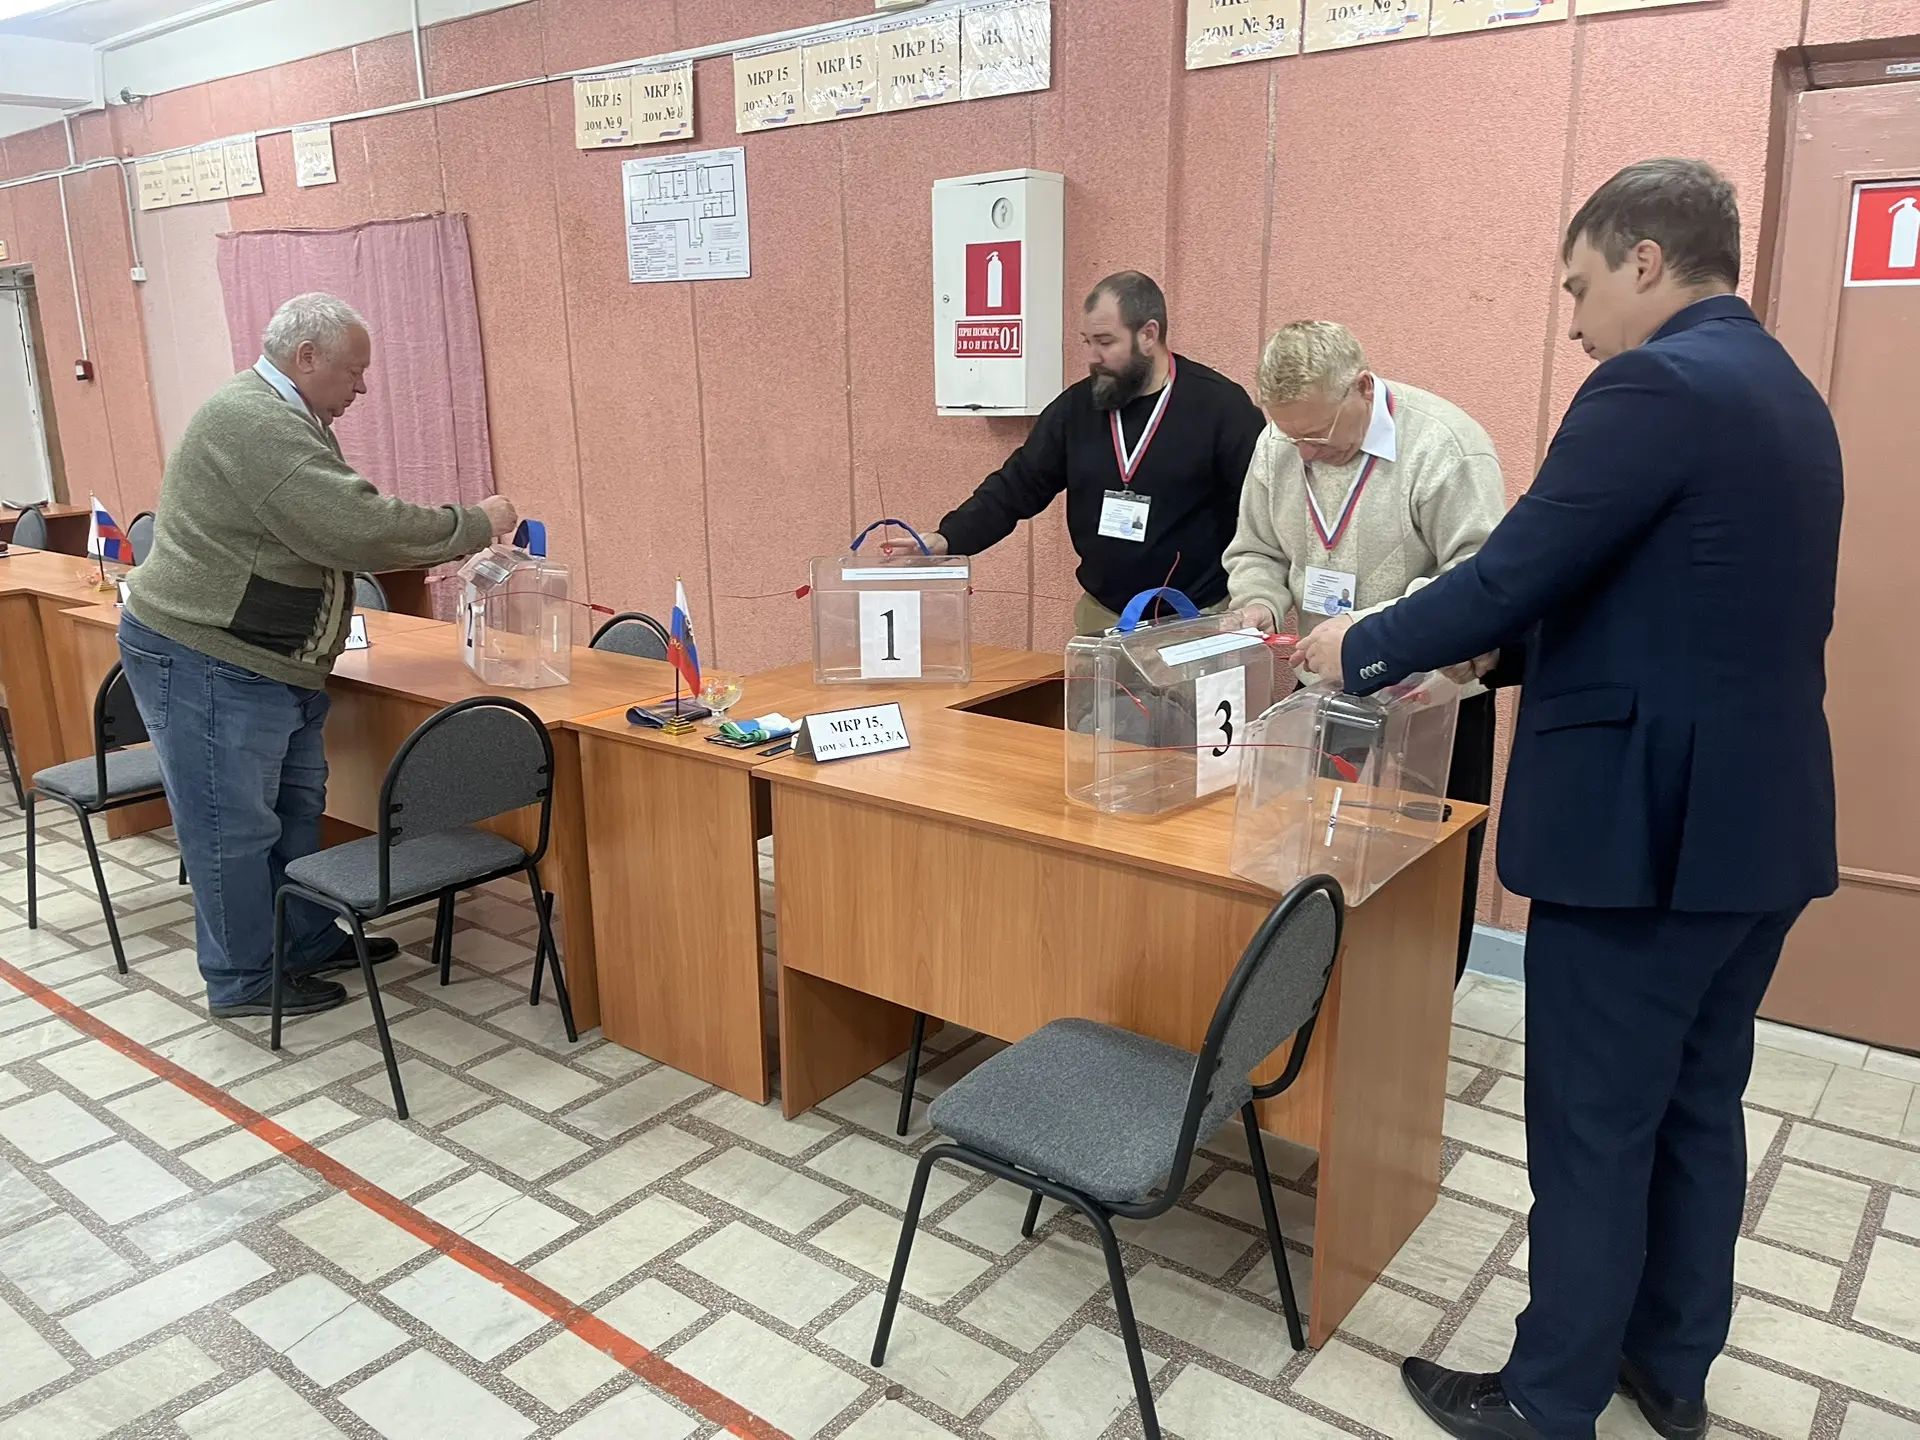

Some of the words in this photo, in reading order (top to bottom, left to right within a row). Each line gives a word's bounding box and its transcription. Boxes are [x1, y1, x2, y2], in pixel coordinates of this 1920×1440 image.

[1369, 0, 1391, 16] №
[1200, 25, 1233, 42] дом
[1239, 17, 1259, 35] №
[1265, 14, 1285, 31] 3а
[892, 40, 925, 59] МКР
[931, 37, 945, 54] 15
[816, 57, 845, 76] МКР
[850, 54, 863, 70] 15
[747, 69, 773, 87] МКР
[777, 66, 789, 81] 15
[890, 74, 916, 88] дом
[644, 84, 670, 99] МКР
[673, 82, 683, 96] 15
[586, 94, 610, 108] МКР
[612, 93, 622, 106] 15
[743, 99, 763, 112] дом
[781, 91, 794, 105] 7а
[584, 120, 602, 131] дом
[604, 116, 615, 130] №
[617, 116, 623, 129] 9
[642, 112, 661, 122] дом
[664, 106, 675, 120] №
[958, 327, 972, 337] ПРИ
[973, 327, 1000, 337] ПОЖАРЕ
[1000, 326, 1019, 351] 01
[957, 340, 1000, 350] ЗВОНИТЬ
[879, 609, 901, 661] 1
[829, 718, 861, 734] МКР
[865, 715, 884, 729] 15,
[1212, 699, 1234, 758] 3
[817, 743, 837, 753] дом
[849, 737, 859, 748] 1,
[861, 735, 872, 746] 2,
[873, 733, 884, 745] 3,
